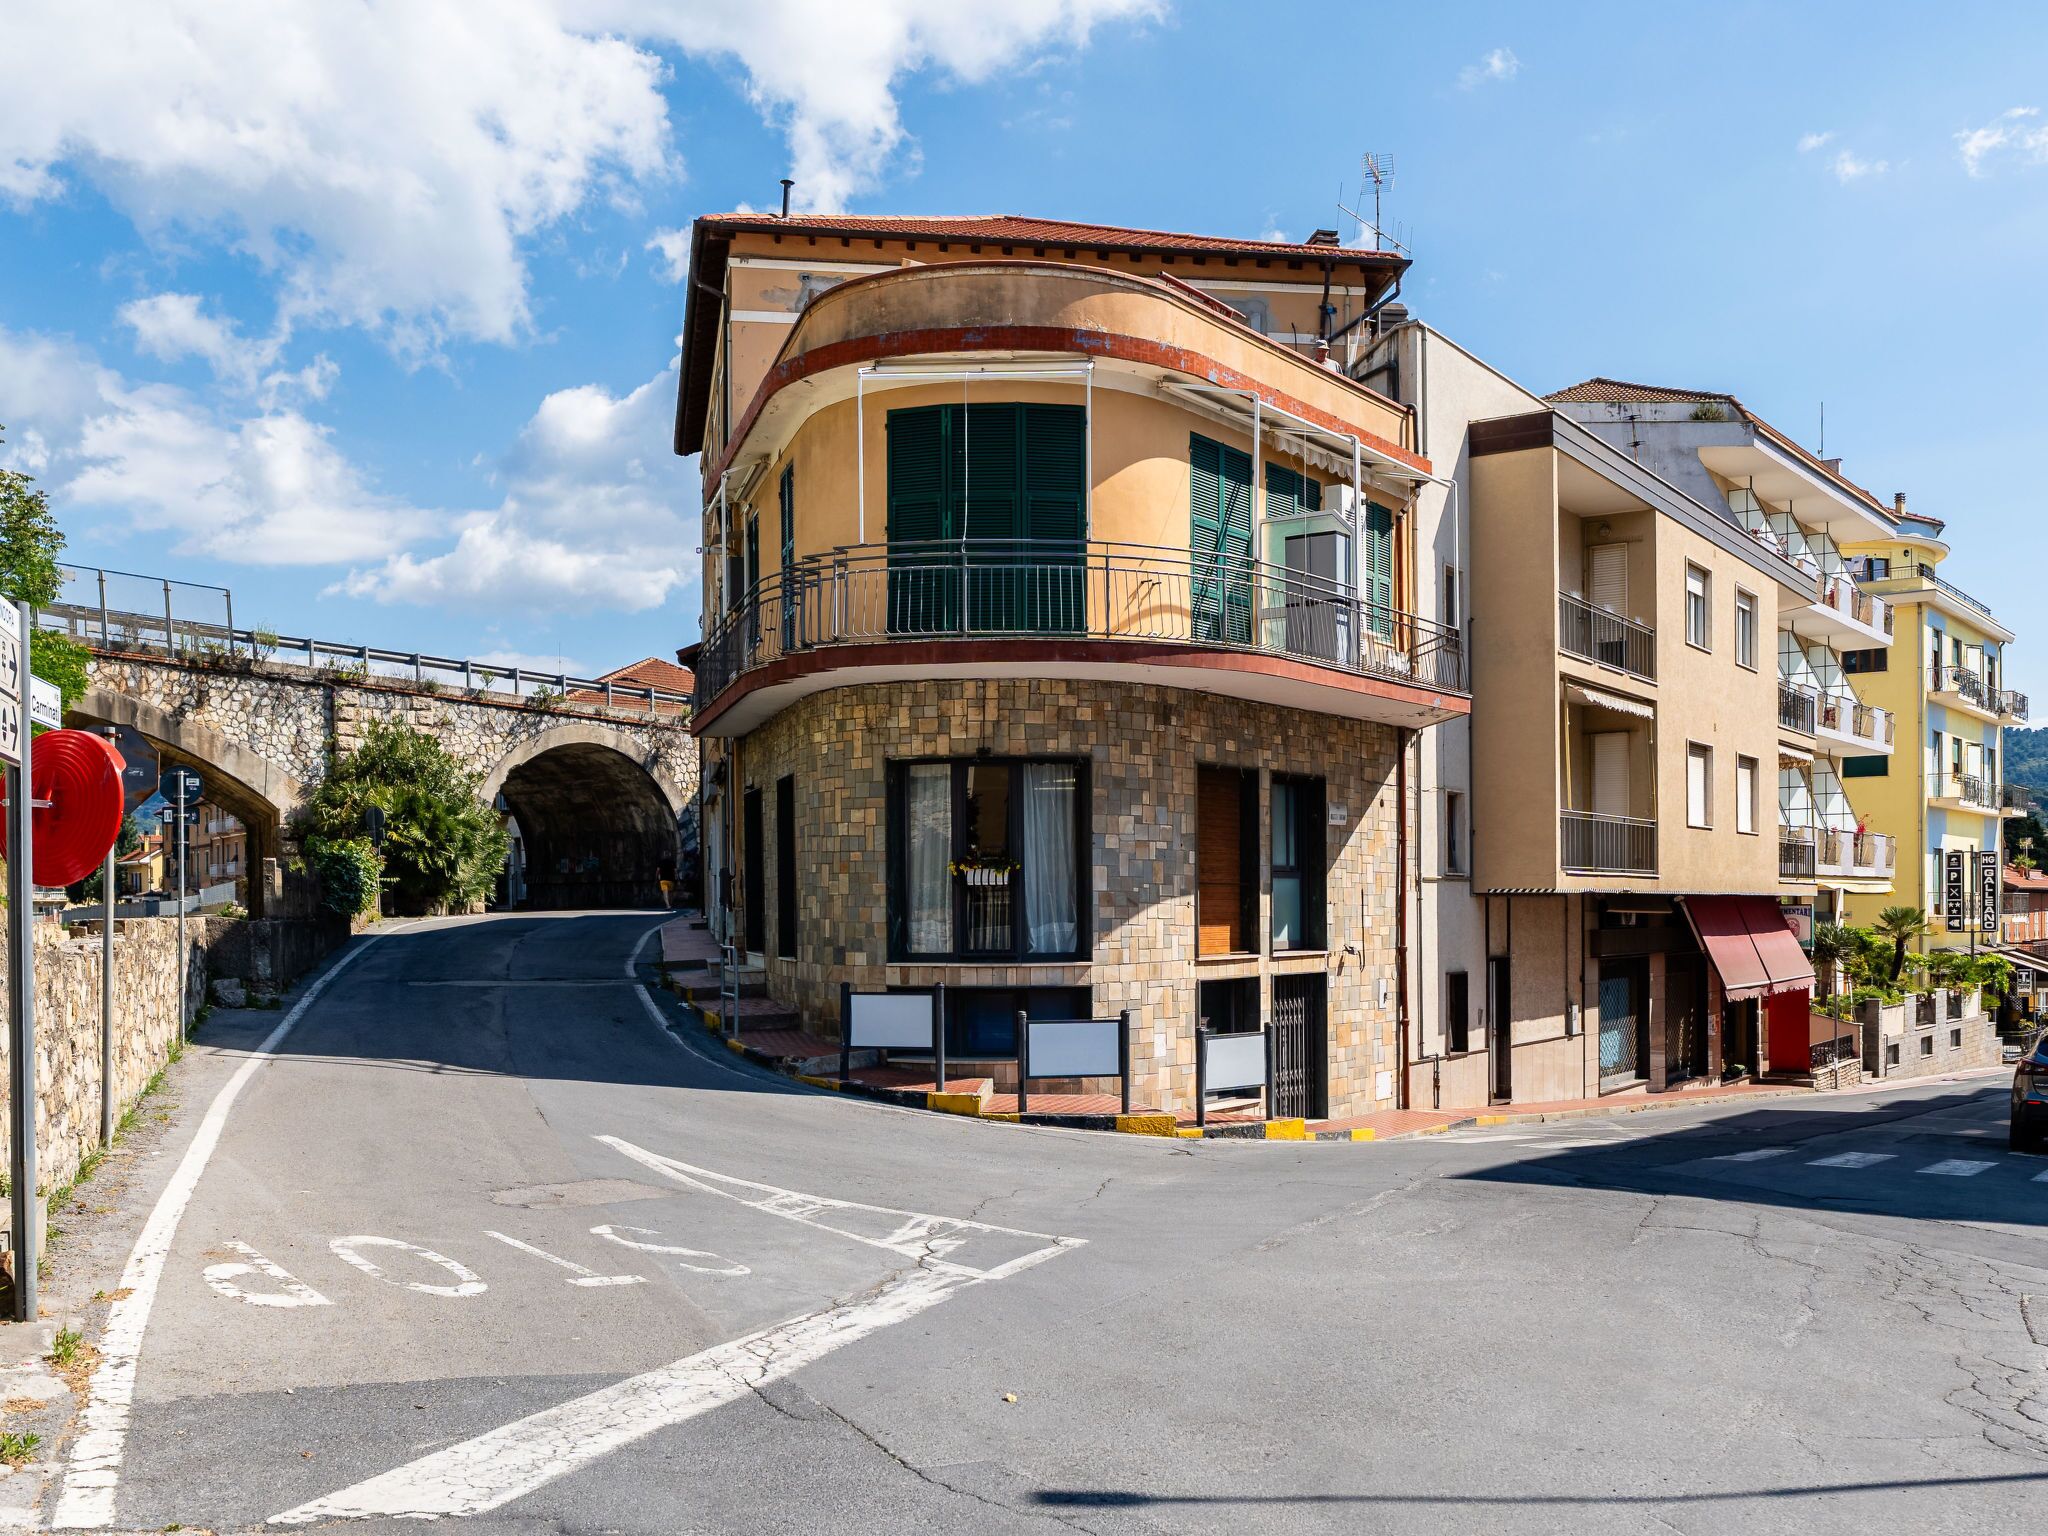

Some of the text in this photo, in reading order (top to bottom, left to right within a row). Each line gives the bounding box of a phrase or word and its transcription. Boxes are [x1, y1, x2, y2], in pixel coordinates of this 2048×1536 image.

[32, 694, 59, 722] Carminati
[1982, 856, 1995, 864] HG
[1950, 871, 1958, 881] P
[1983, 869, 1995, 929] GALLEANO
[2019, 971, 2029, 982] T
[202, 1224, 751, 1308] STOP
